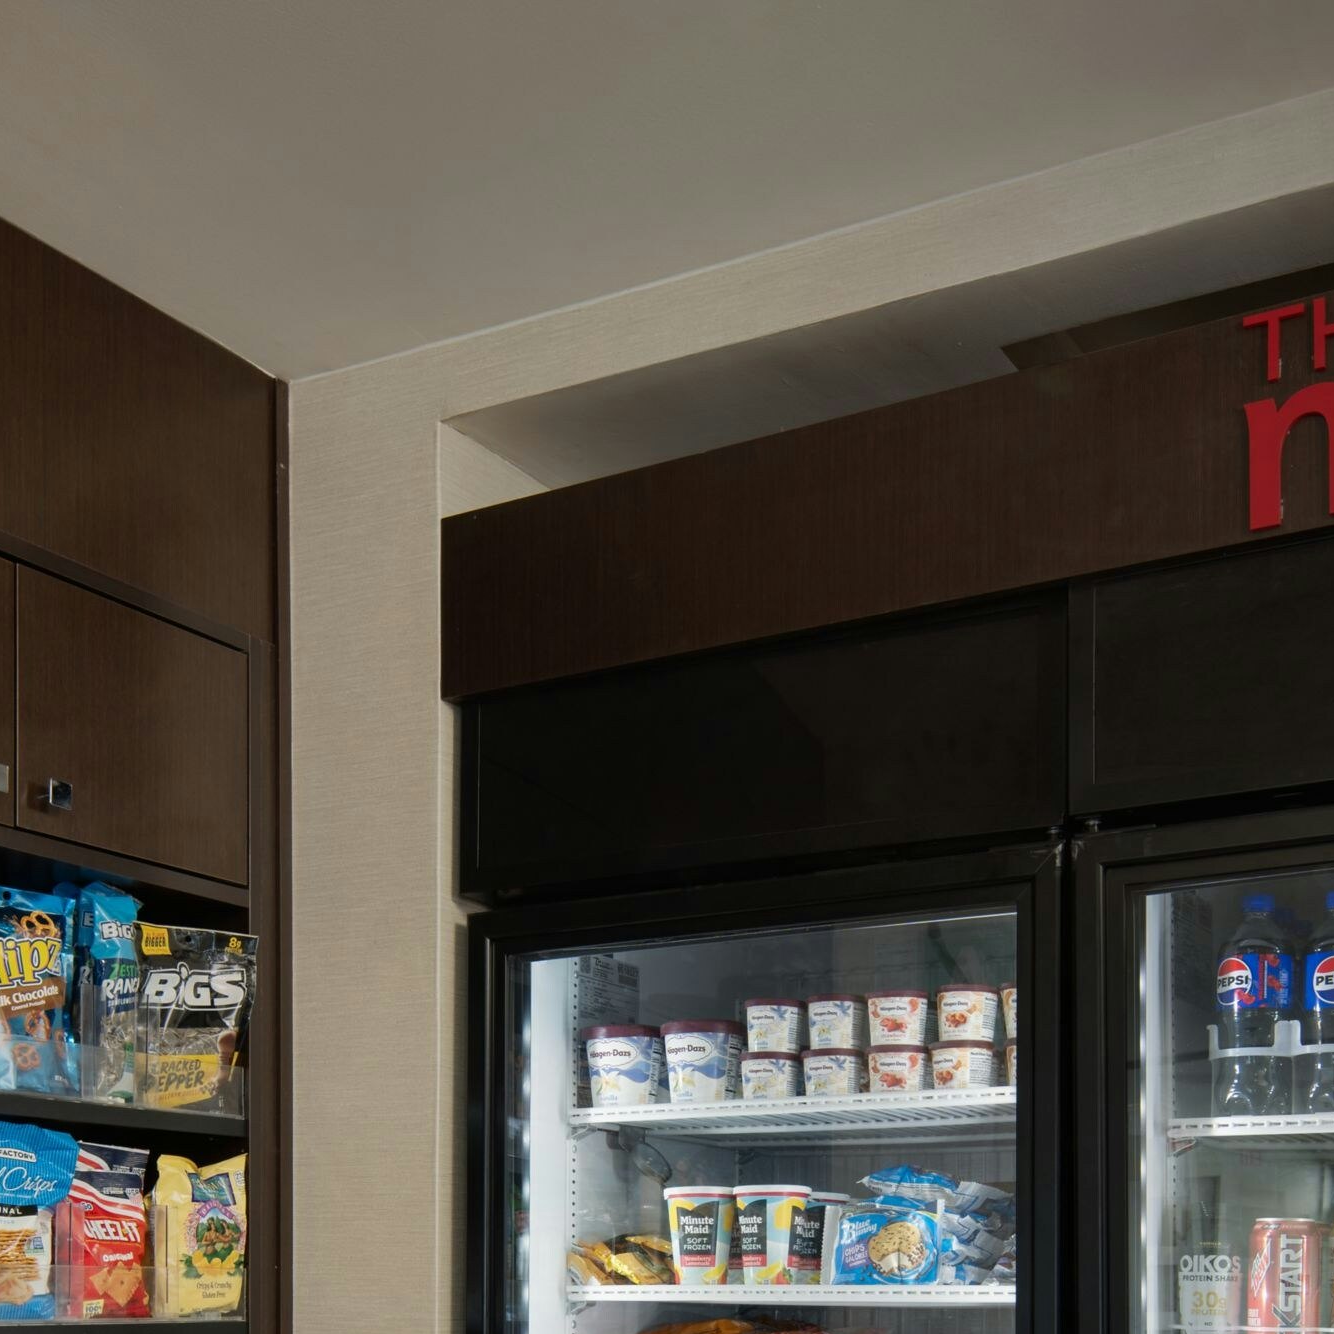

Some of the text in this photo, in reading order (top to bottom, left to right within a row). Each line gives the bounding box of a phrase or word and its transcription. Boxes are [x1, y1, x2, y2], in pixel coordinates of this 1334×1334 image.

[1217, 974, 1251, 989] PEPSI
[12, 985, 59, 1003] Chocolate
[2, 1166, 58, 1193] Crisps
[680, 1216, 714, 1226] Minute
[684, 1225, 709, 1235] Maid
[1178, 1254, 1241, 1274] OIKOS
